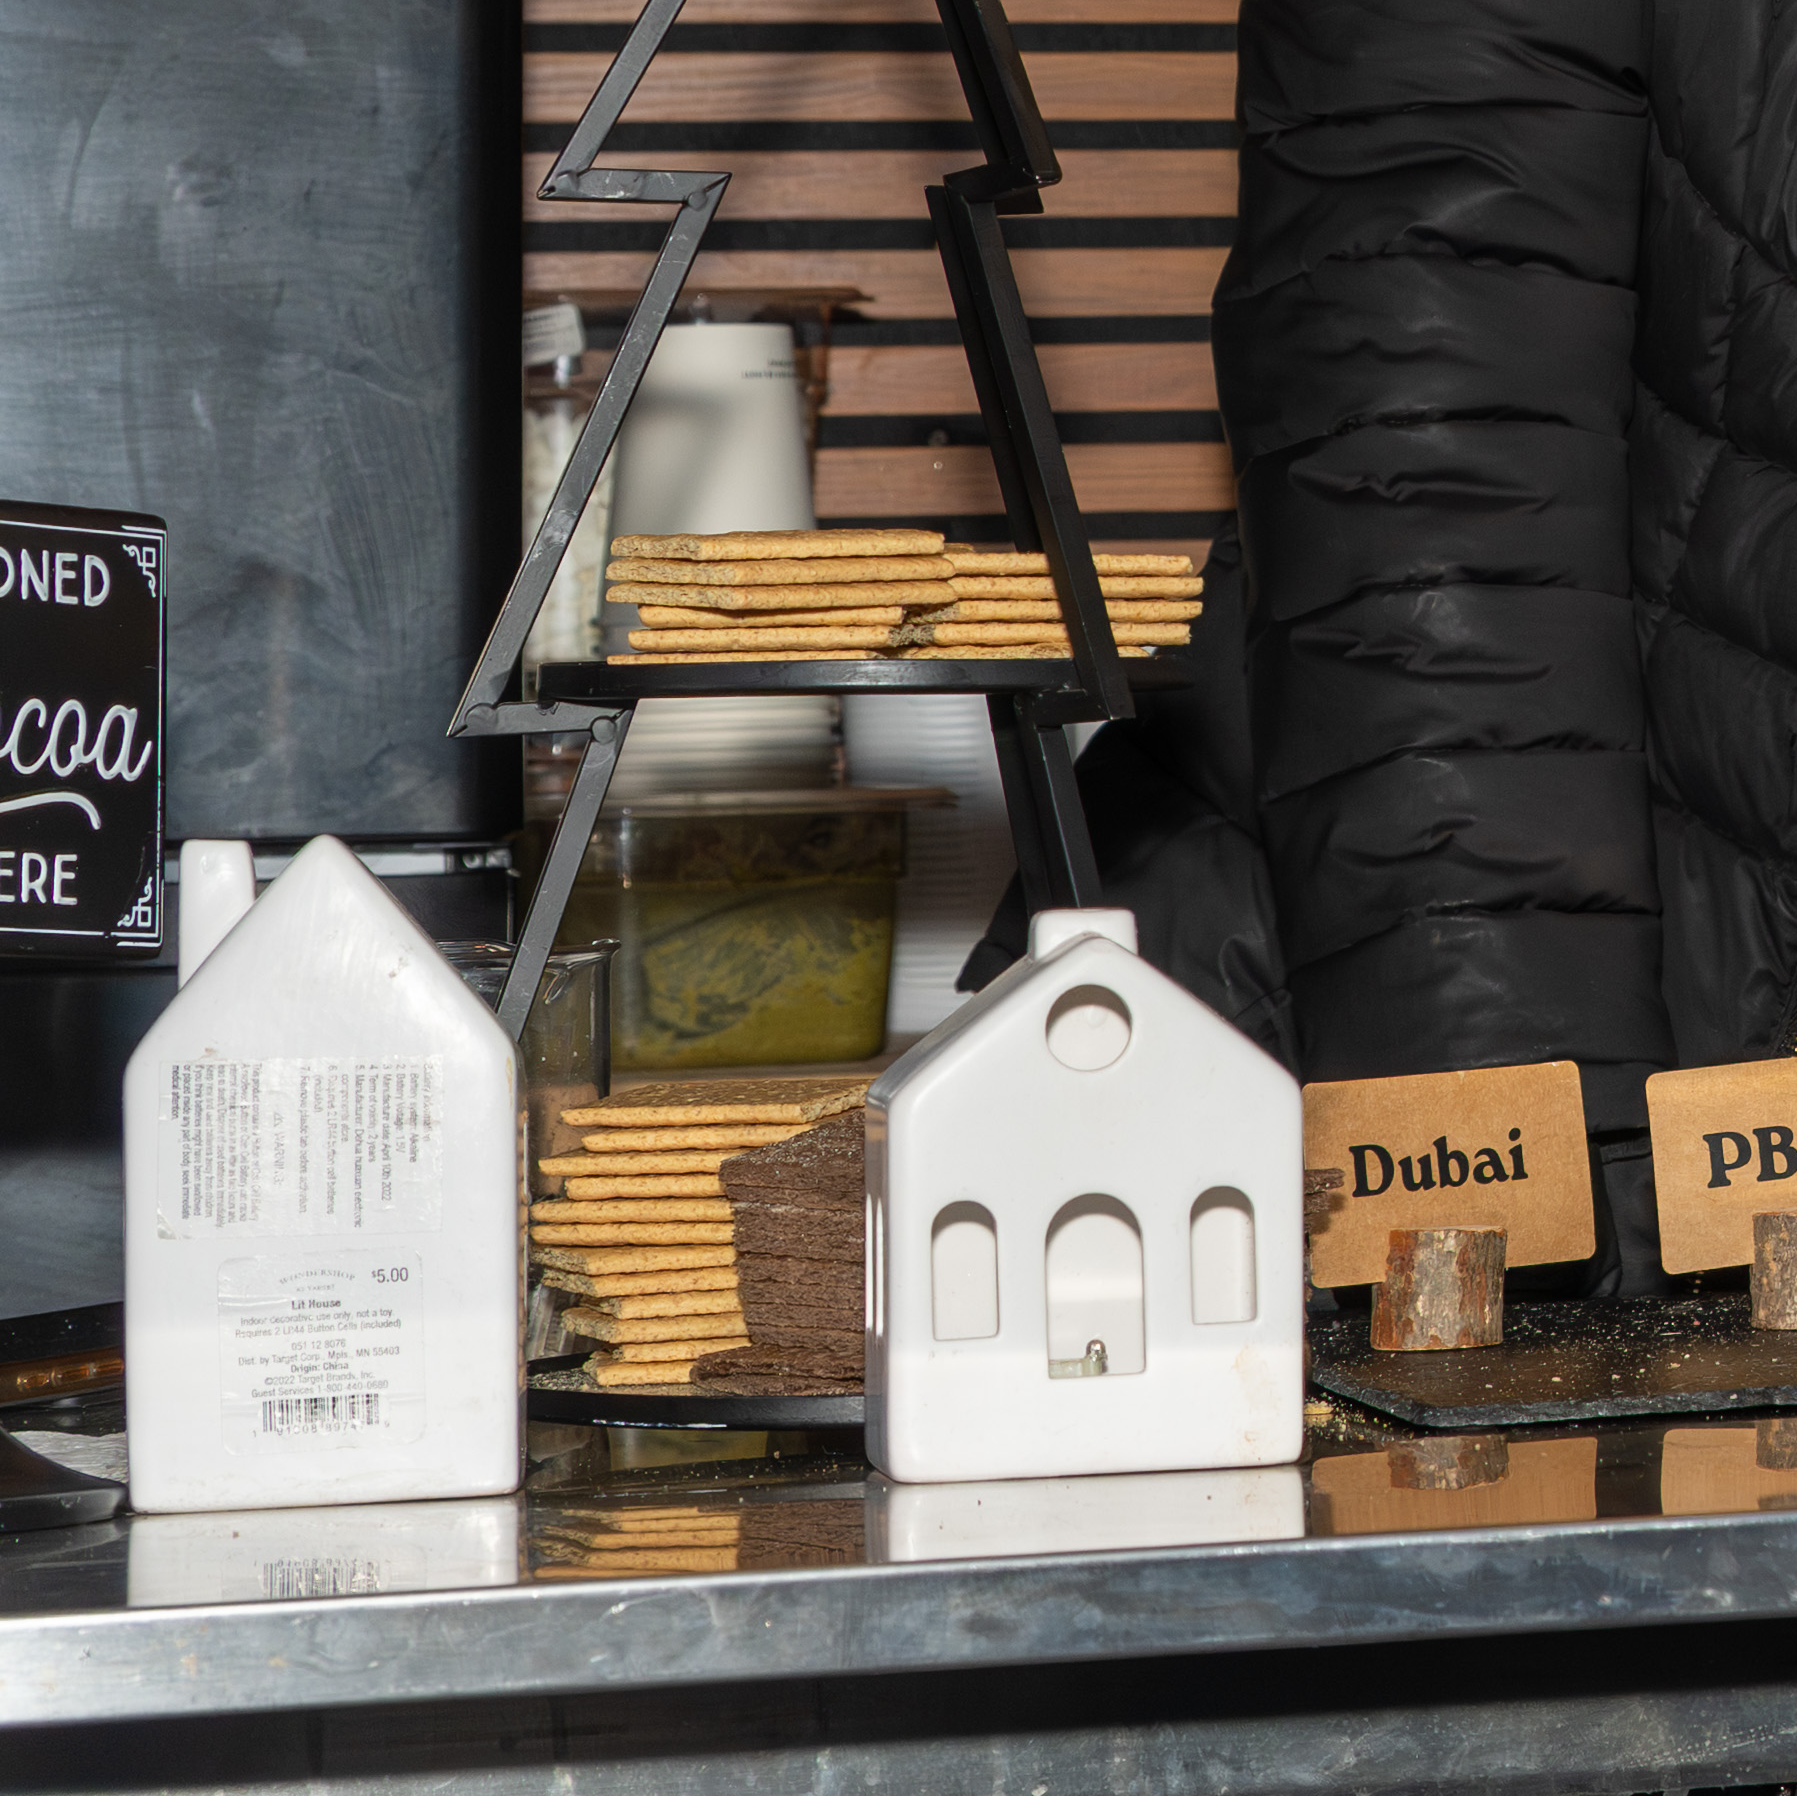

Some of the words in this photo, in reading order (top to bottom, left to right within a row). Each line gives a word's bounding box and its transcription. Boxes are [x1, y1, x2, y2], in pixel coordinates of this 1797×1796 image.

[1348, 1127, 1529, 1197] Dubai
[371, 1267, 408, 1283] $5.00
[292, 1300, 305, 1310] Lit
[309, 1299, 341, 1309] House
